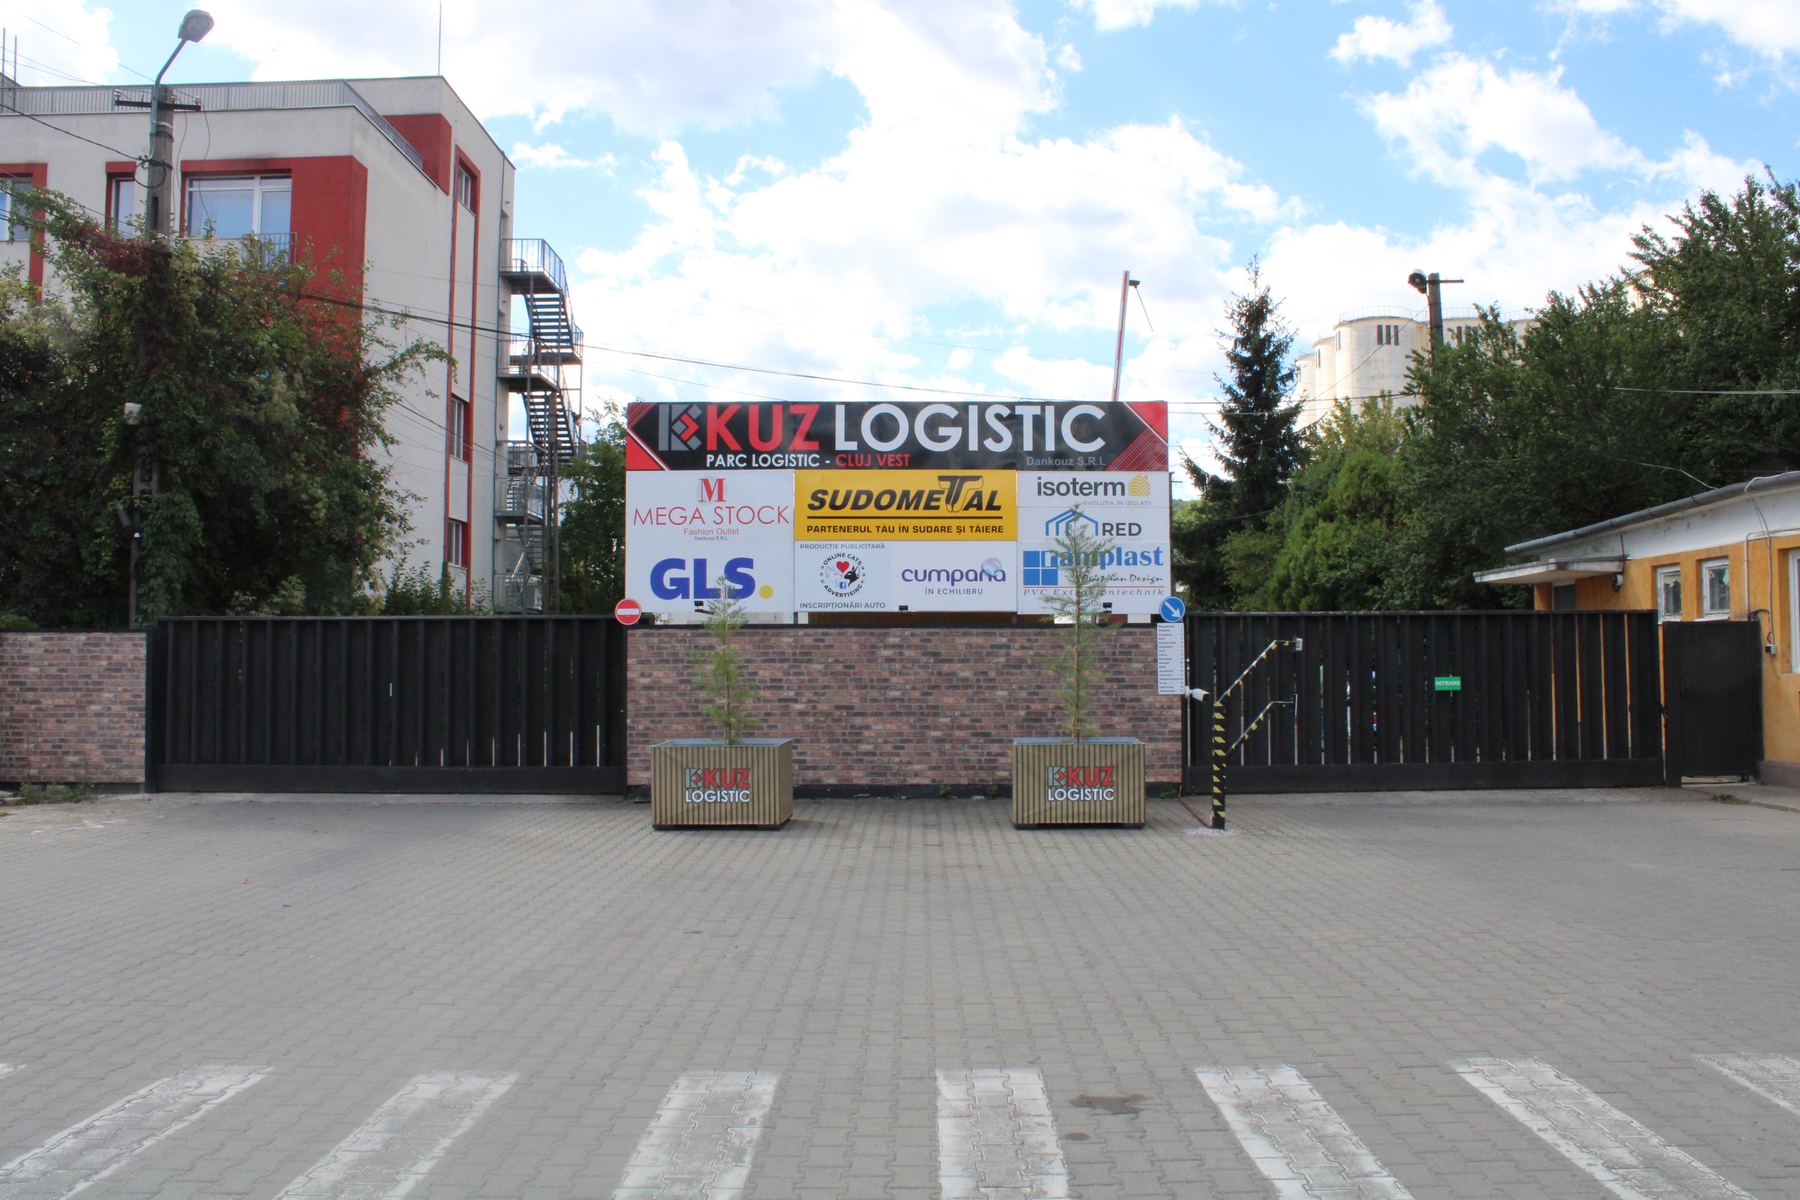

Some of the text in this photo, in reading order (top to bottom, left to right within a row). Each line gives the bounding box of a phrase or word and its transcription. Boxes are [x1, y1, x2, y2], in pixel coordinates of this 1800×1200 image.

[706, 404, 820, 451] KUZ
[835, 403, 1106, 452] LOGISTIC
[706, 454, 747, 467] PARC
[752, 454, 820, 467] LOGISTIC
[836, 454, 872, 466] CLUJ
[877, 453, 911, 466] VEST
[1026, 456, 1074, 466] Dankouz
[698, 478, 727, 503] M
[1037, 476, 1125, 496] isoterm
[807, 475, 1002, 513] SUDOMETAL
[633, 505, 789, 526] MEGA STOCK
[807, 525, 872, 533] PARTENERUL
[912, 525, 953, 533] SUDARE
[1103, 522, 1142, 536] RED
[823, 552, 863, 566] ONLINE CATS
[1130, 573, 1163, 584] Design
[823, 584, 863, 598] ADVERTISING
[925, 586, 934, 595] ÎN
[704, 768, 751, 788] KUZ
[1067, 767, 1115, 787] KUZ
[686, 790, 750, 802] LOGISTIC
[1048, 788, 1114, 800] LOGISTIC
